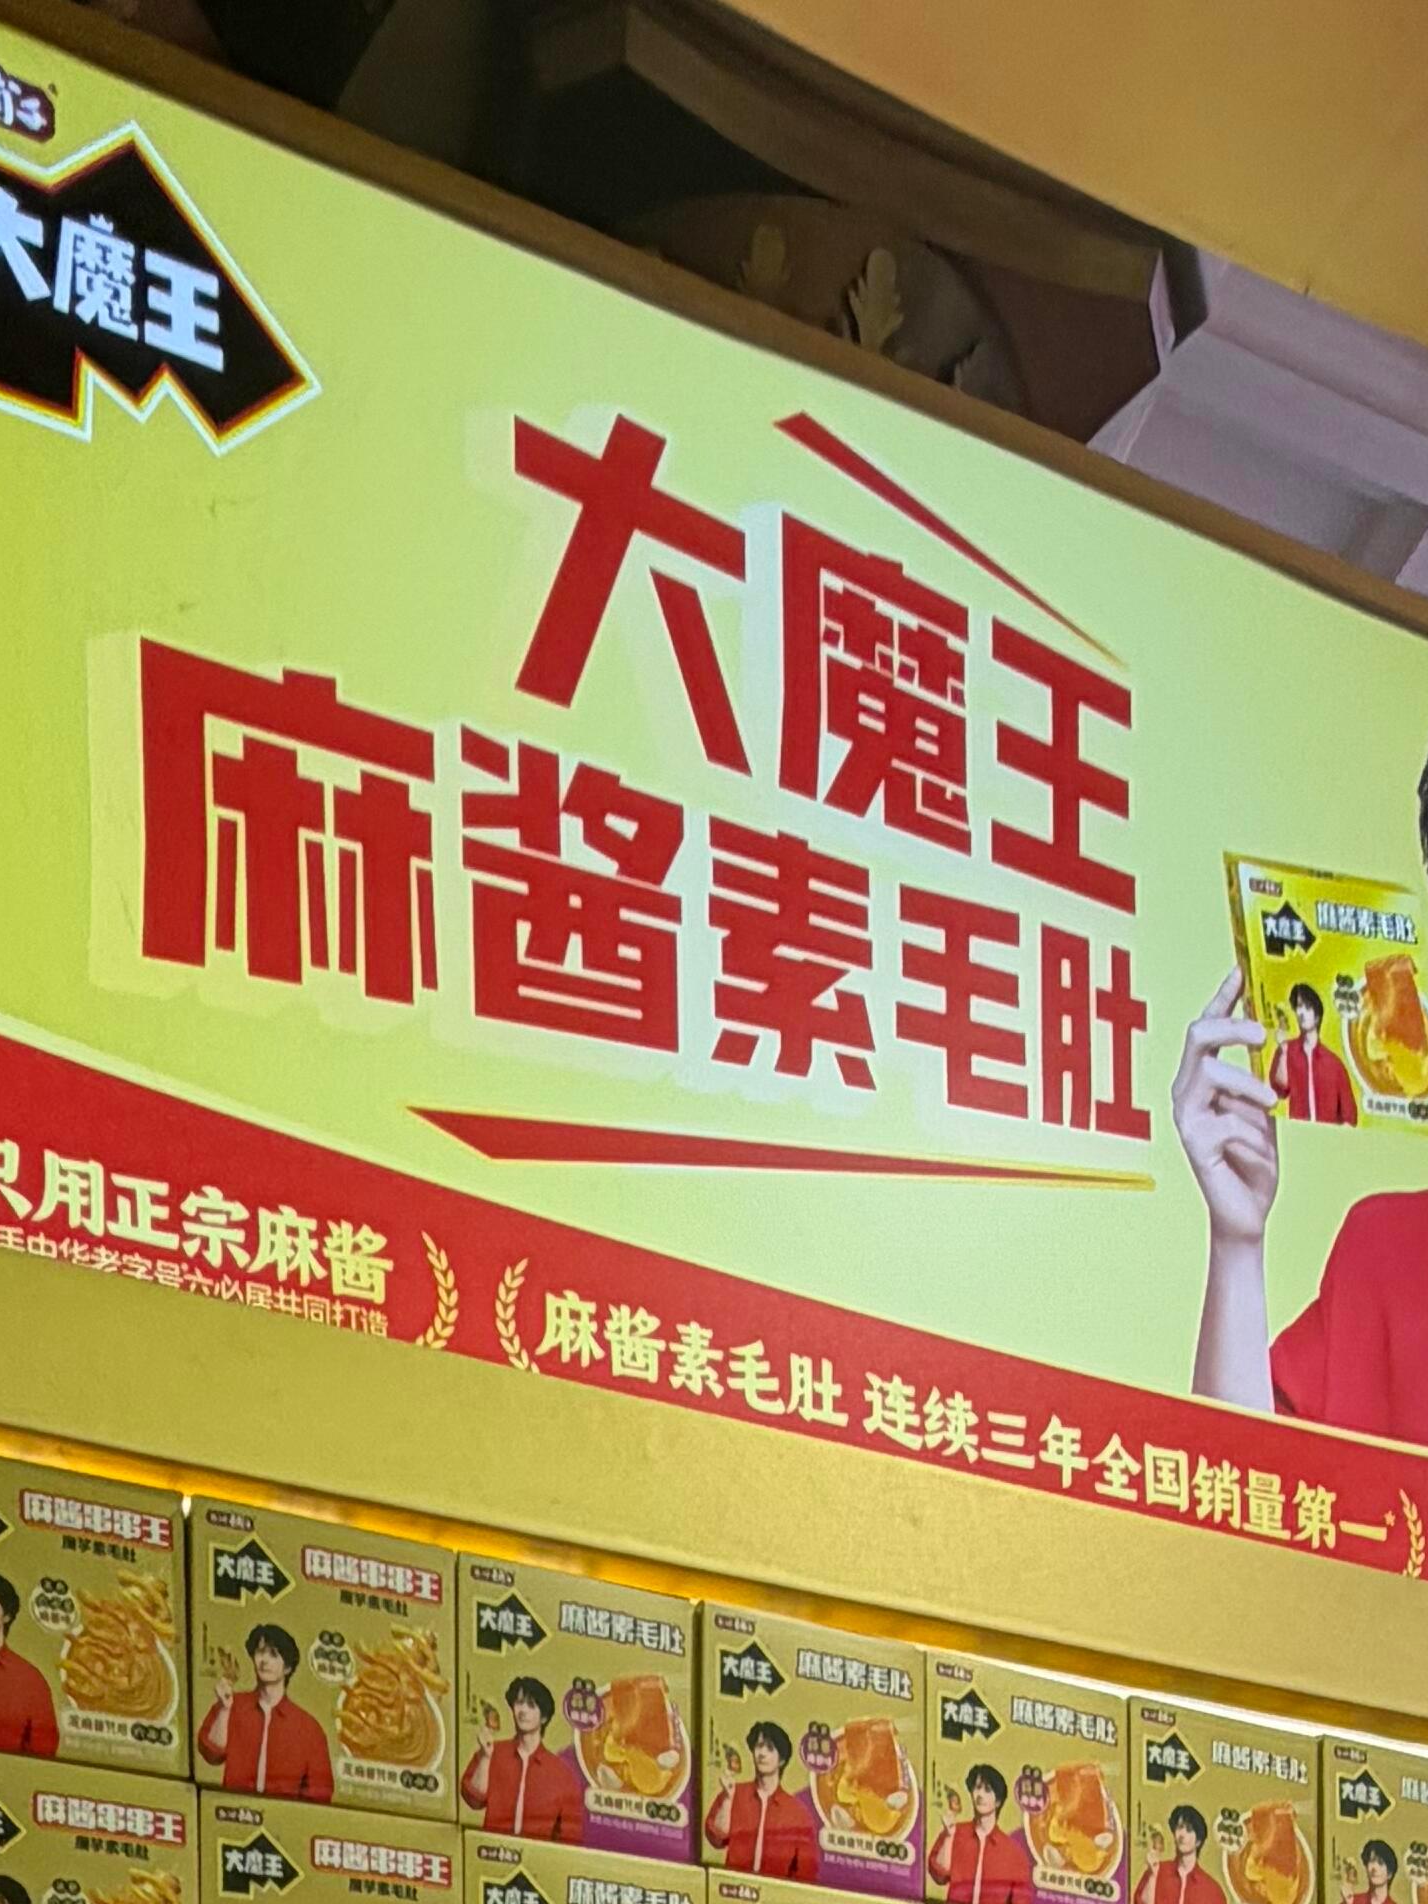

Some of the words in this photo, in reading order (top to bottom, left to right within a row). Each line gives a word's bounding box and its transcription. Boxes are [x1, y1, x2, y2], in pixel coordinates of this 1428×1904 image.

[140, 636, 1150, 1140] 麻酱素毛肚
[514, 414, 1135, 915] 大魔王
[534, 1292, 847, 1428] 麻酱素毛肚
[863, 1372, 1390, 1550] 连续三年全国销量第一
